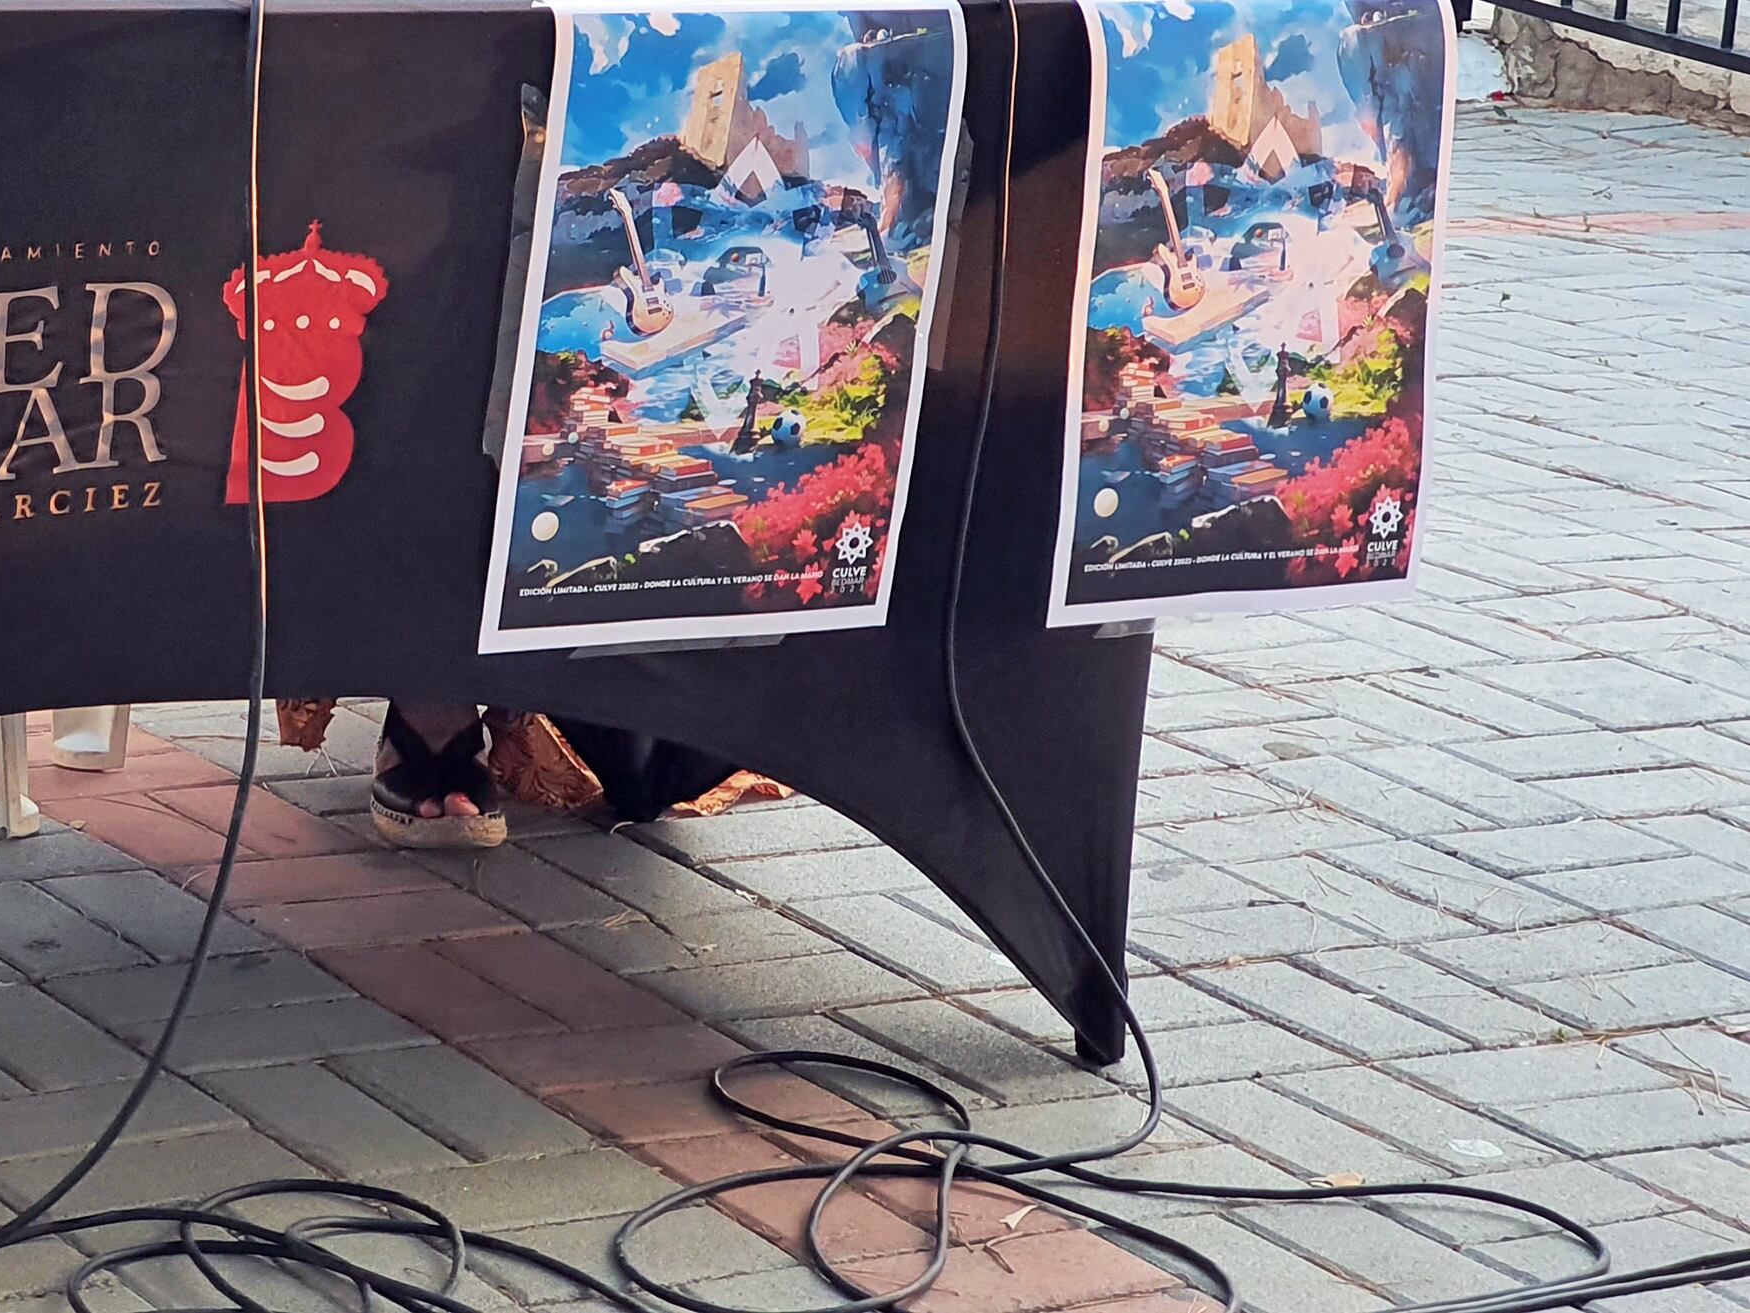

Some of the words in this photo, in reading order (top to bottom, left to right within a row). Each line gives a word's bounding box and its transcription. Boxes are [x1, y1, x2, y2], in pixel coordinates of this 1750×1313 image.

[1367, 539, 1399, 553] CULVE
[832, 565, 867, 578] CULVE
[519, 585, 552, 597] EDICIÓN
[553, 585, 588, 595] LIMITADA
[593, 583, 617, 593] CULVE
[643, 580, 671, 589] DONDE
[672, 579, 682, 587] LA
[682, 576, 717, 586] CULTURA
[717, 577, 722, 585] Y
[722, 576, 732, 585] EL
[732, 574, 763, 584] VERANO
[790, 572, 800, 580] LA
